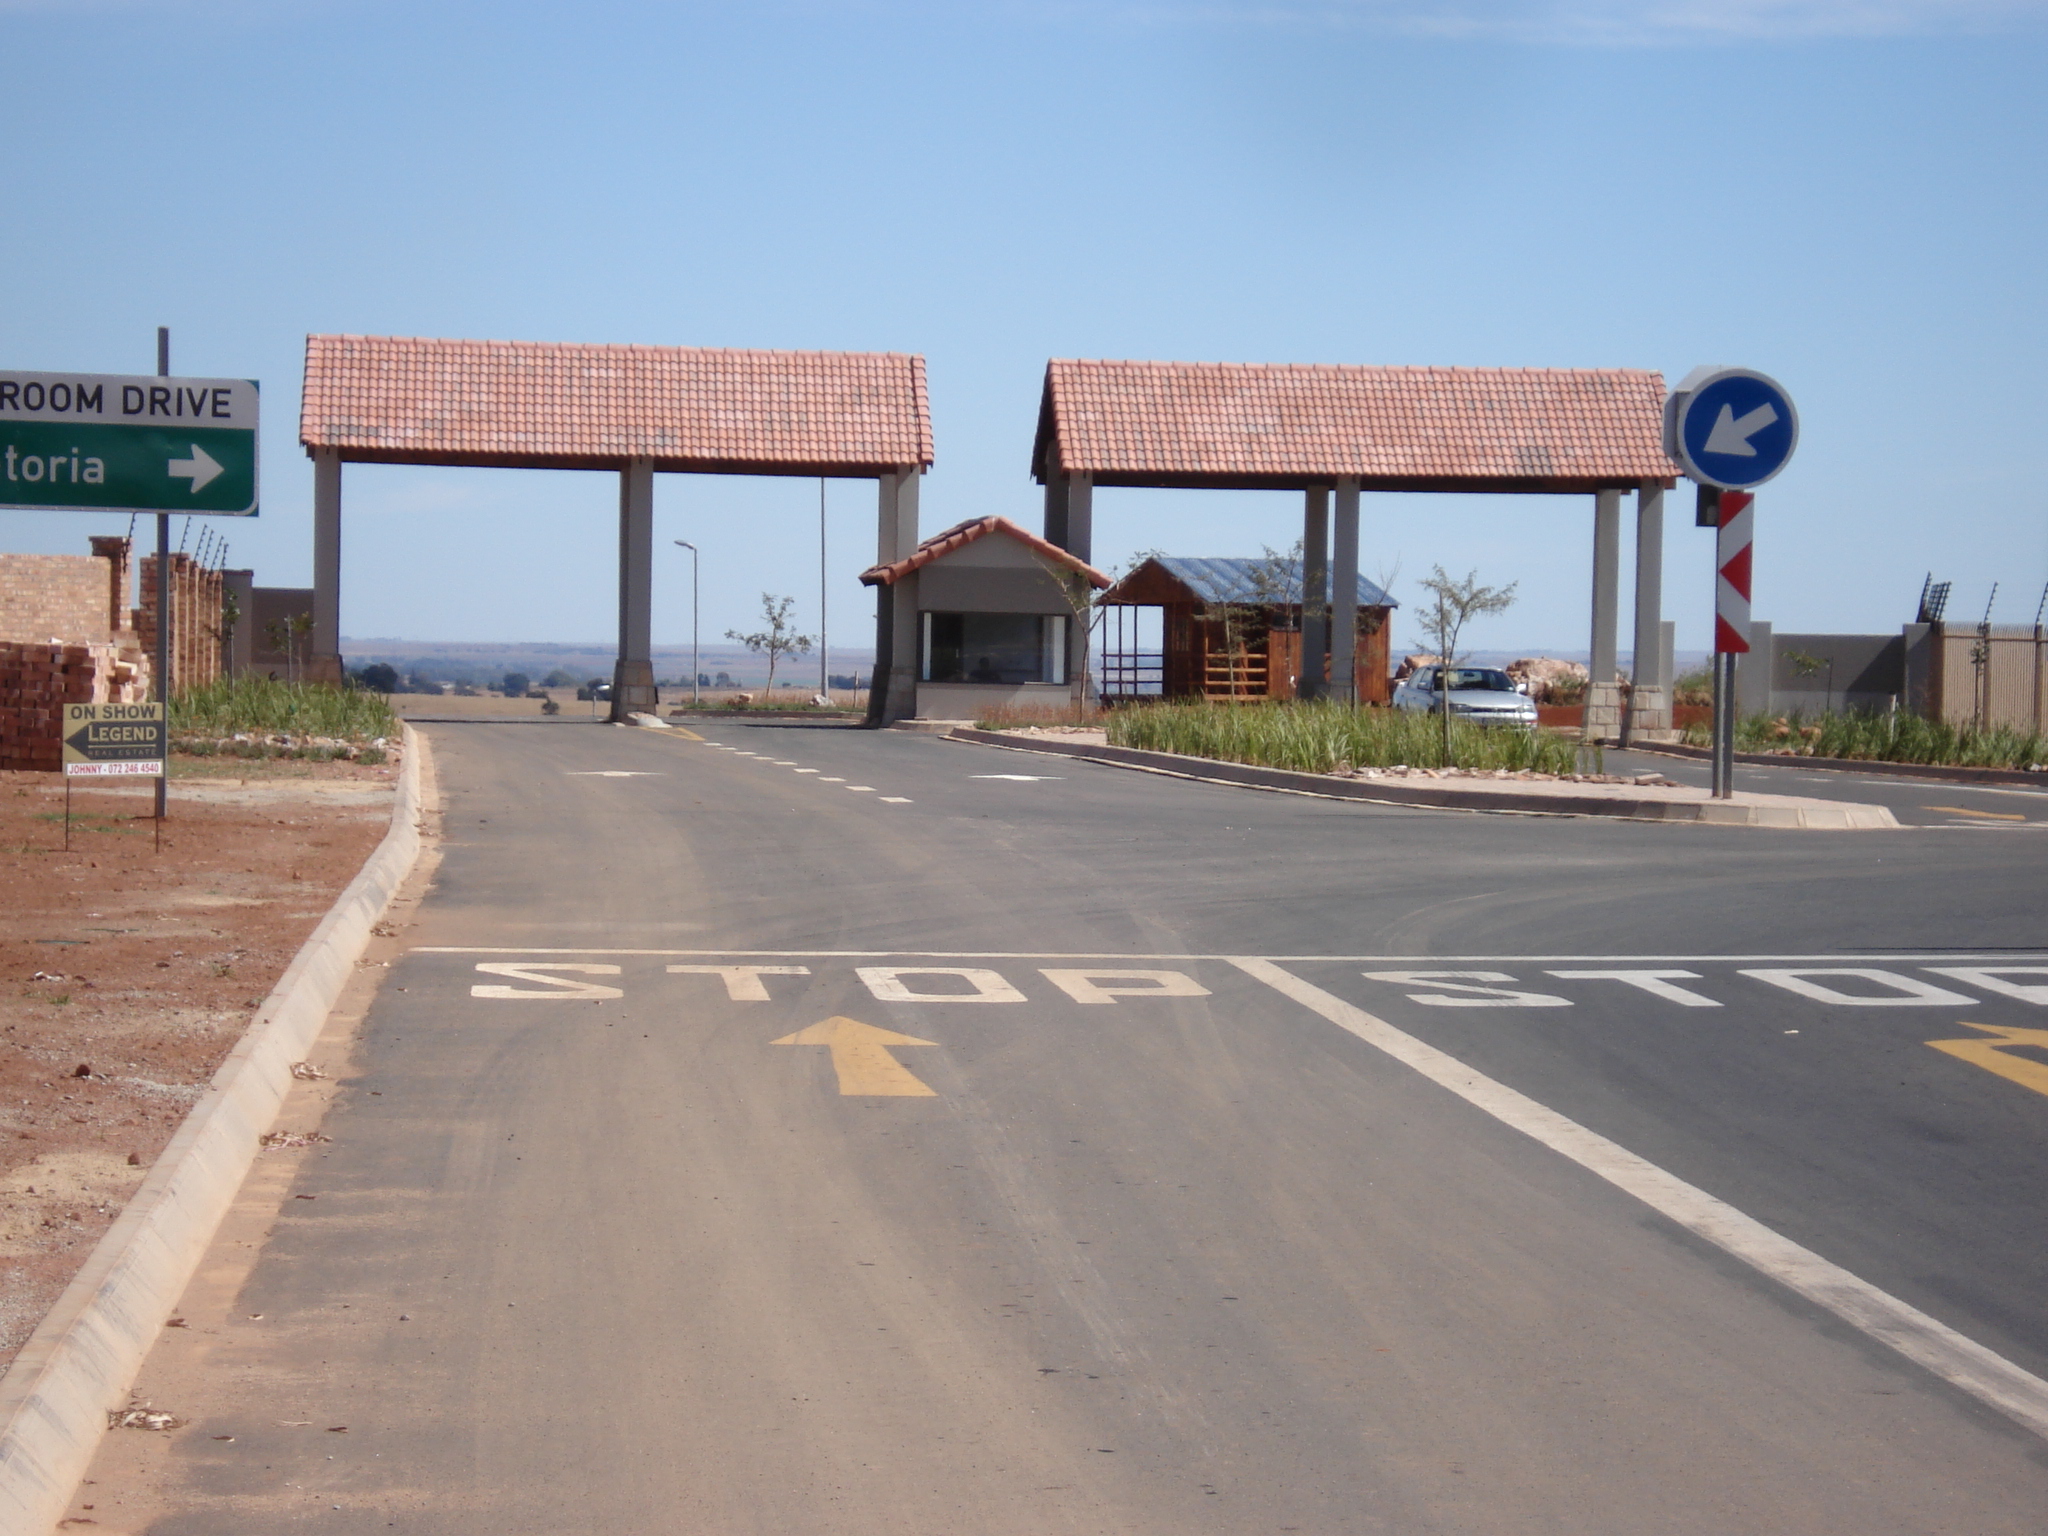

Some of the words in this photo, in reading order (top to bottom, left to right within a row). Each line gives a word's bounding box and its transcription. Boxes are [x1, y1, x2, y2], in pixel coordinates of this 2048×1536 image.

[0, 380, 104, 413] ROOM
[122, 385, 232, 418] DRIVE
[5, 444, 104, 484] toria
[70, 705, 96, 719] ON
[102, 705, 156, 719] SHOW
[88, 724, 158, 742] LEGEND
[118, 748, 157, 756] ESTATE
[69, 764, 102, 775] JOHNNY
[108, 764, 122, 774] 072
[124, 763, 139, 774] 246
[140, 763, 160, 773] 4540
[470, 962, 1212, 1004] STOP
